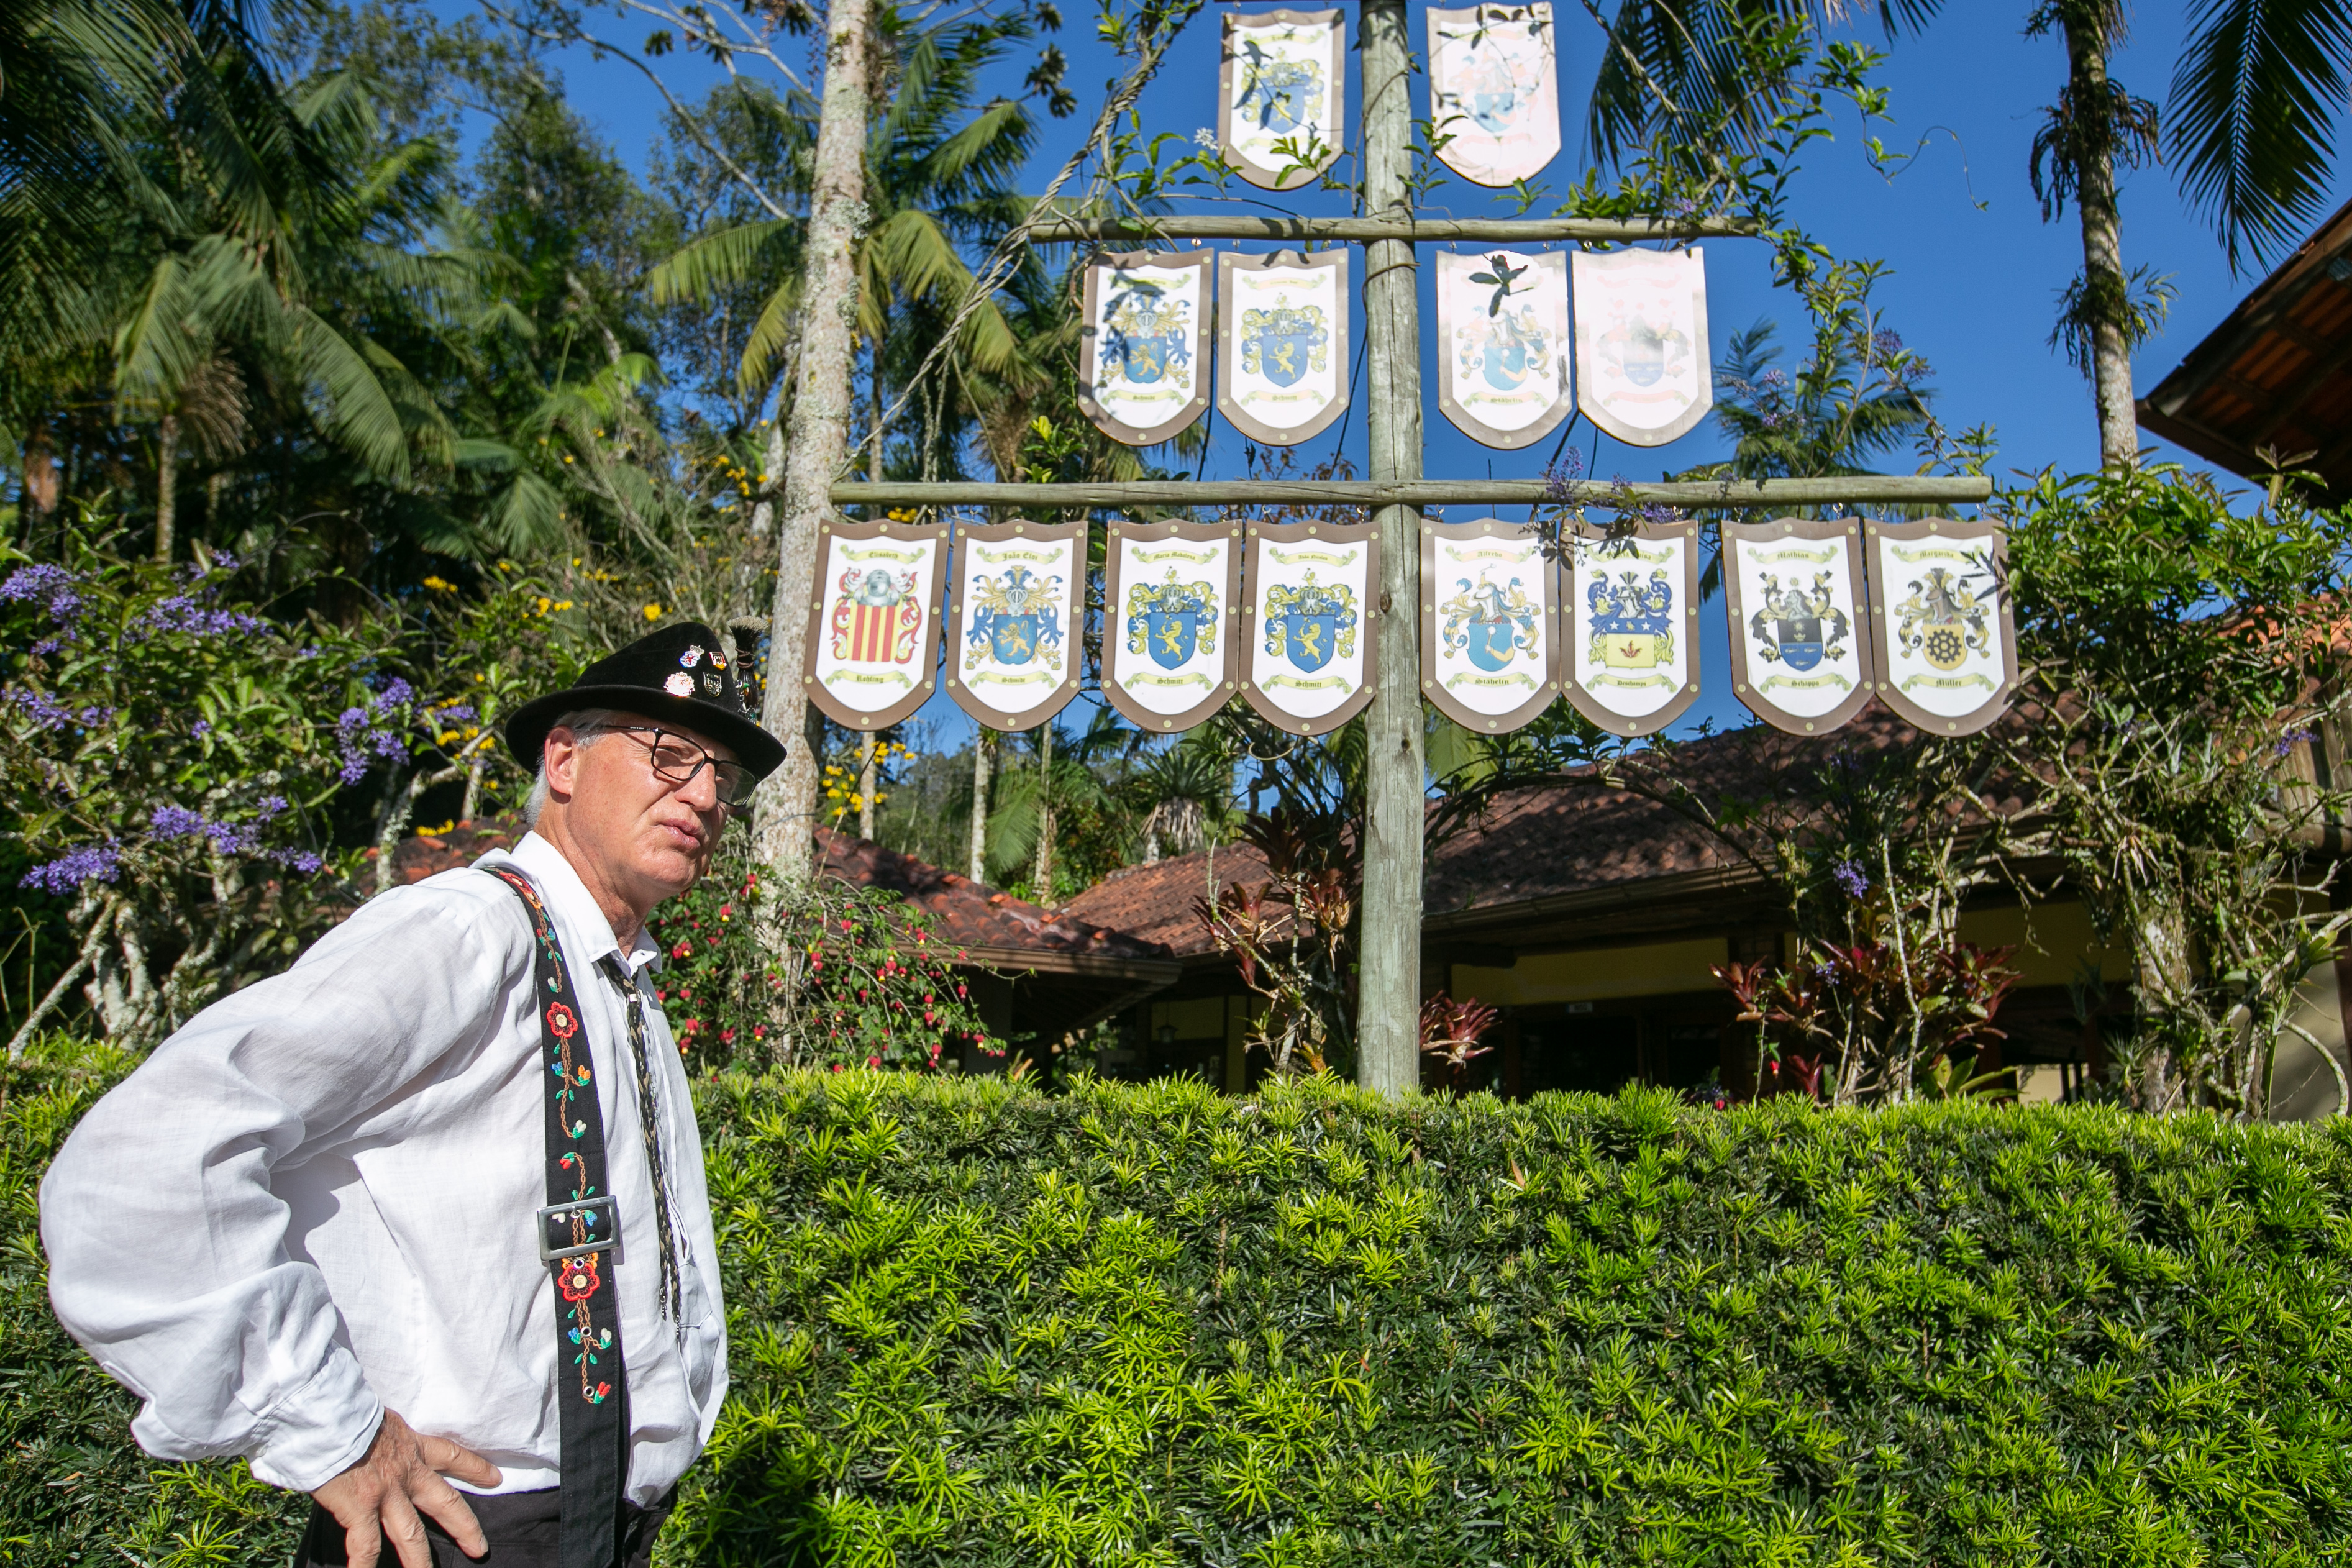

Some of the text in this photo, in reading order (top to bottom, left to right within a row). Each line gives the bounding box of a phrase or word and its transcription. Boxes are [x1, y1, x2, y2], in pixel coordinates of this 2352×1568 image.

[1001, 552, 1038, 562] João Eloi
[1777, 552, 1809, 560] Mathias
[1936, 678, 1962, 688] Müller
